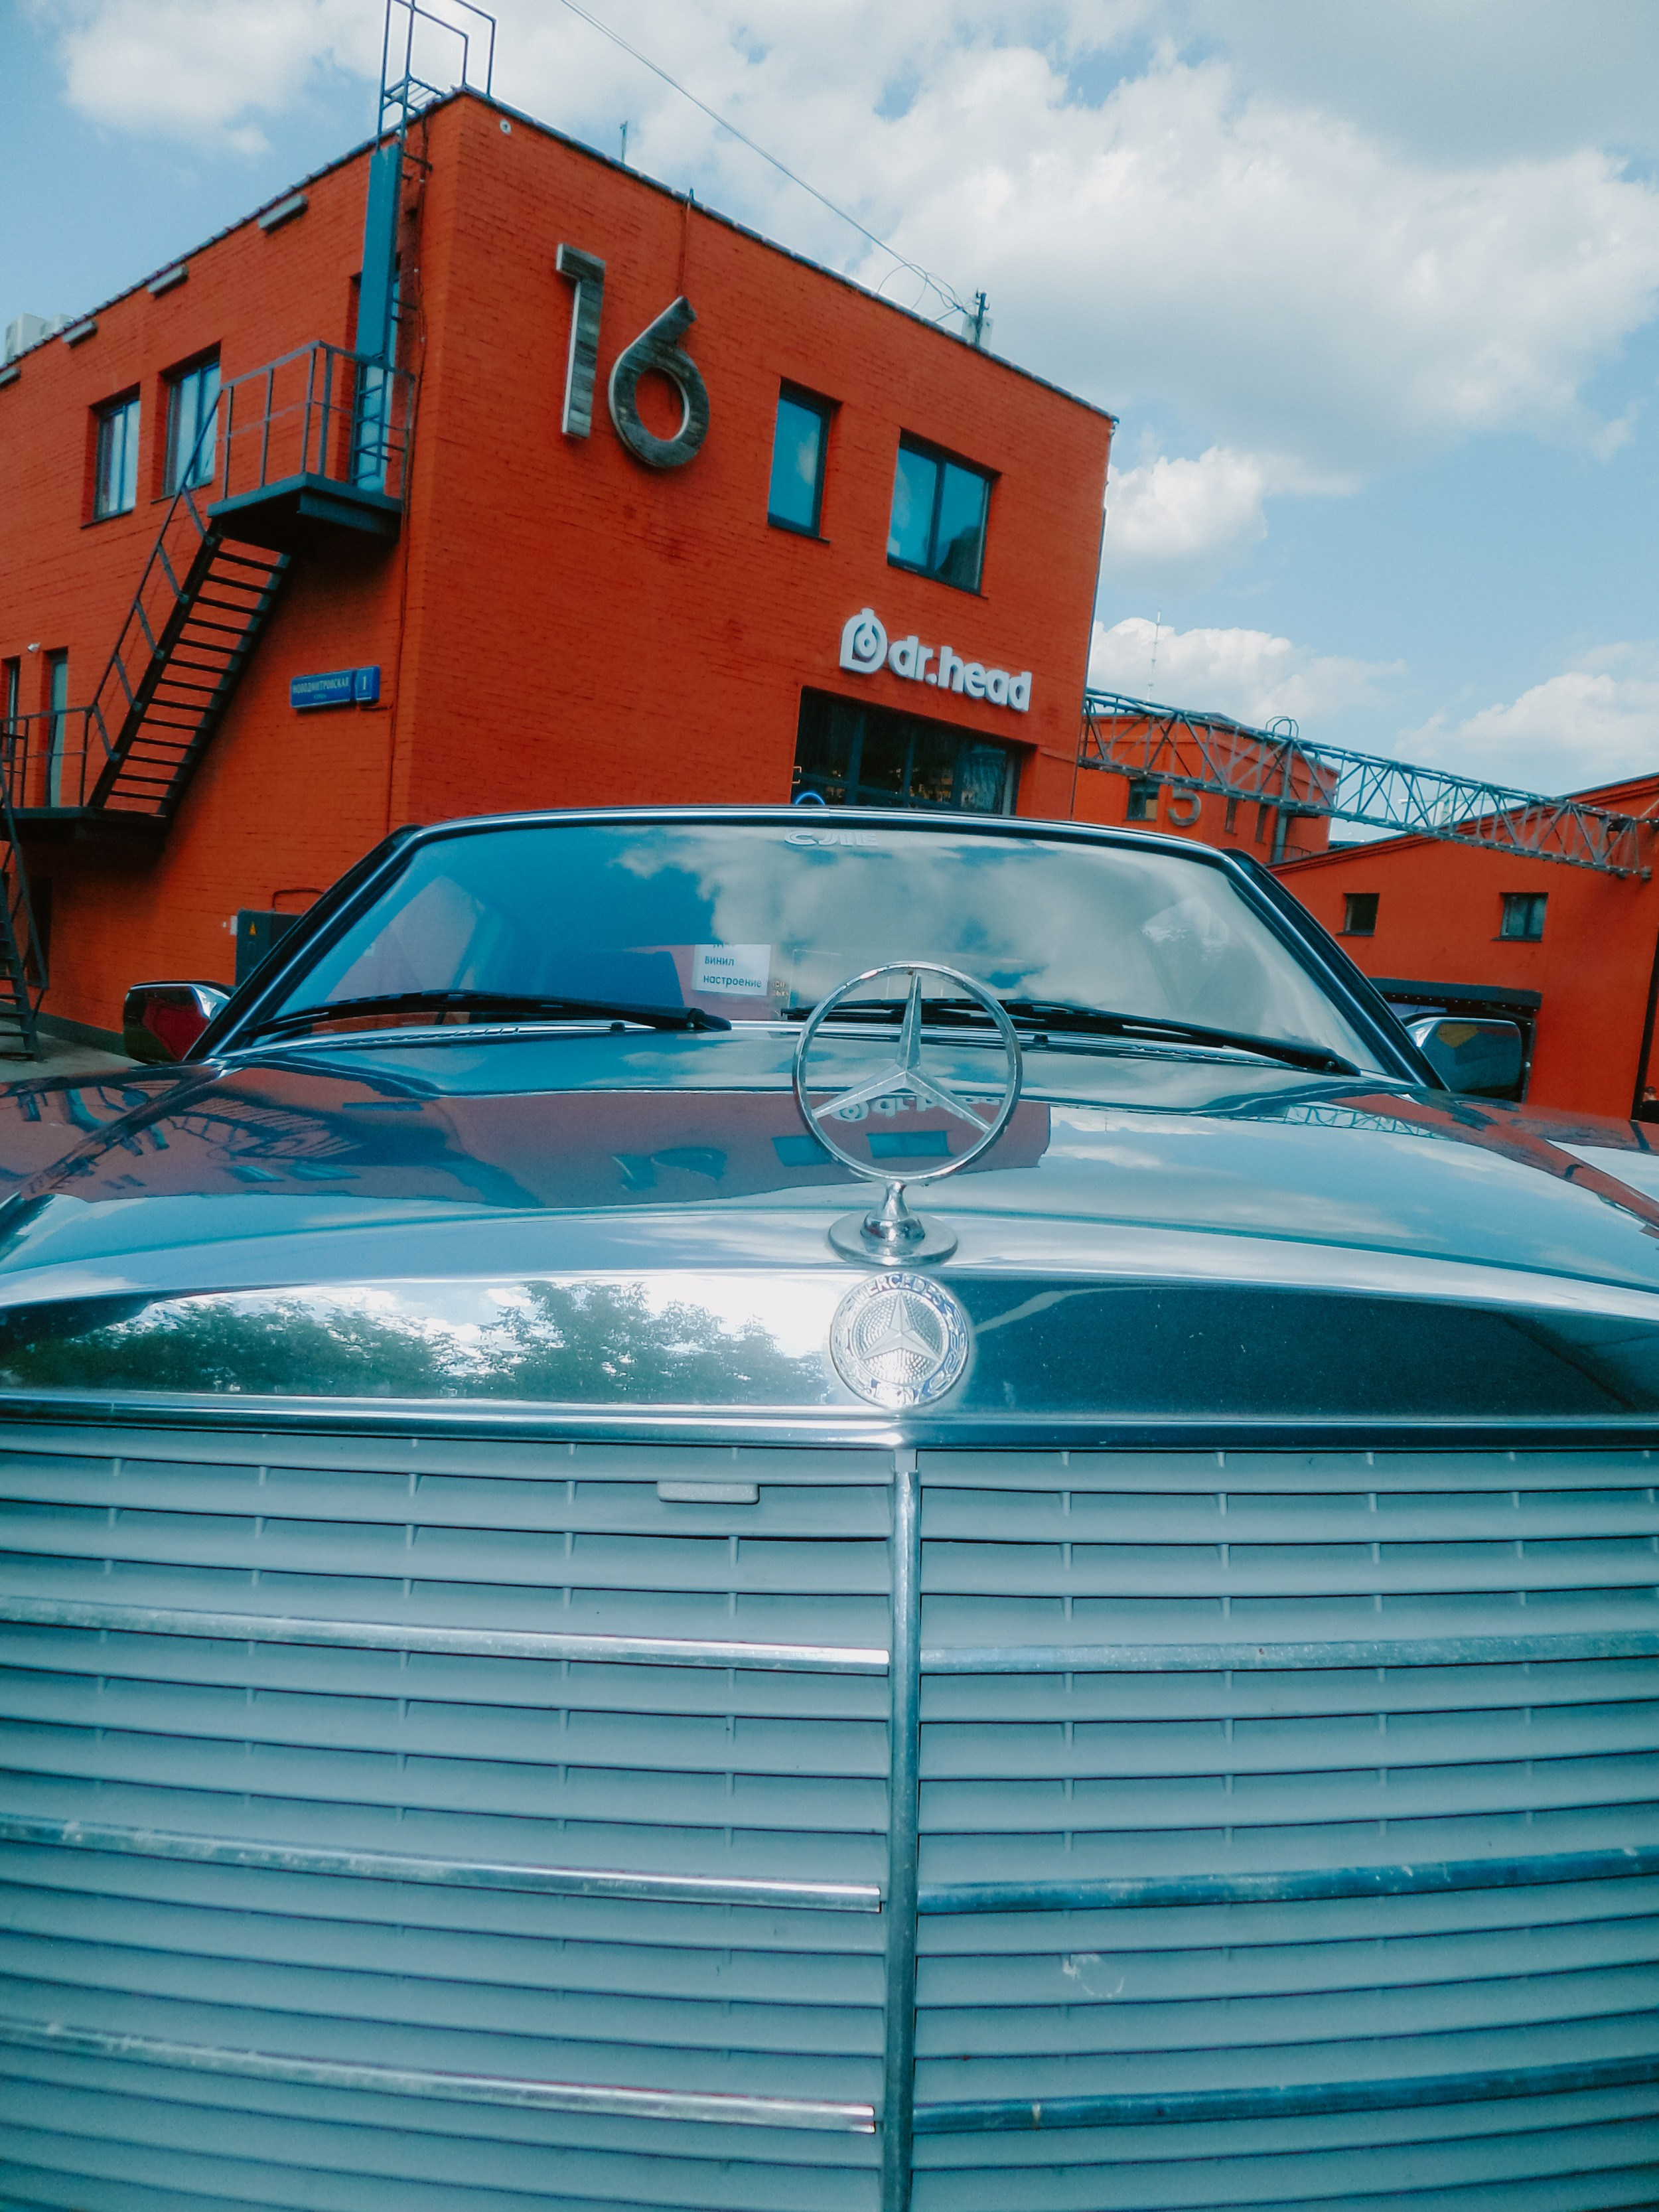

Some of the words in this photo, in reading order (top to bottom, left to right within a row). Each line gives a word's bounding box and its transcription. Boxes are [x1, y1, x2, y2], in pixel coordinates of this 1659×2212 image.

[555, 243, 709, 467] 16
[362, 676, 367, 690] 1
[888, 634, 1033, 712] dr.head
[1168, 786, 1202, 827] 5
[705, 956, 735, 966] винил
[703, 975, 762, 988] настроение
[851, 1273, 945, 1305] MERCEDES
